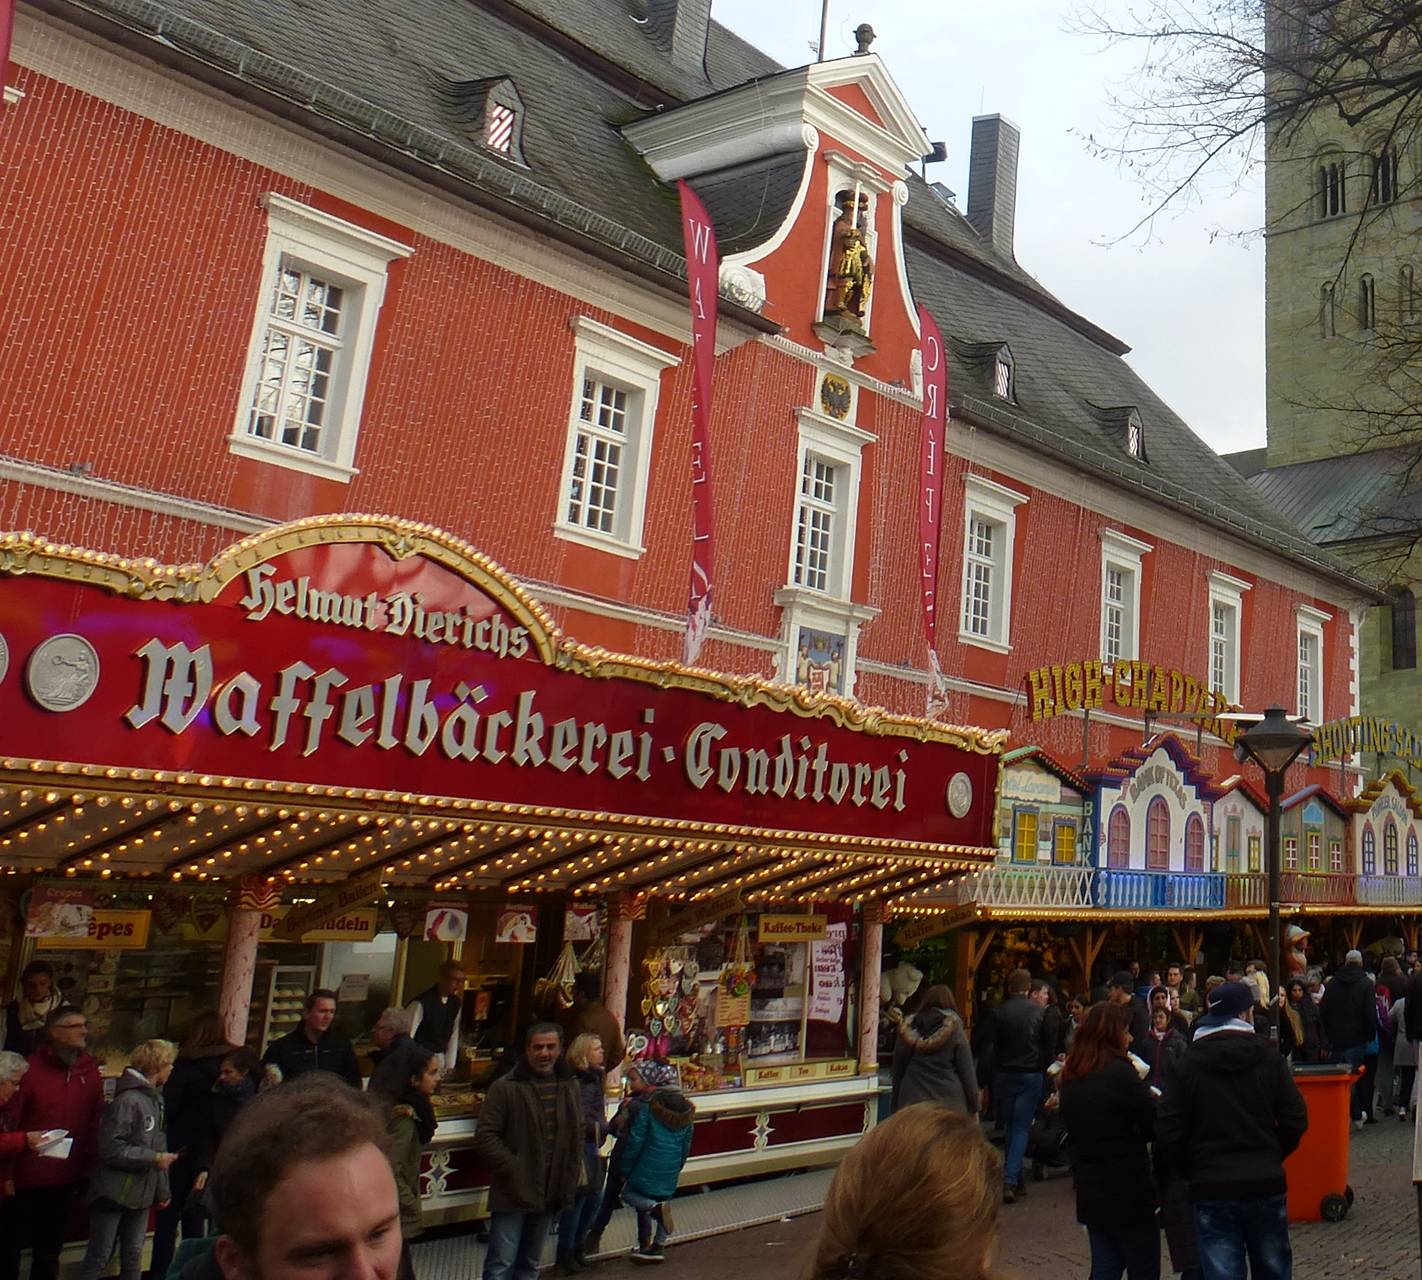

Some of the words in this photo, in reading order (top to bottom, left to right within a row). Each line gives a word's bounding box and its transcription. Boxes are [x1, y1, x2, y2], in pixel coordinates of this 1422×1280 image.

[241, 563, 378, 632] Helmut
[384, 592, 529, 660] Dierichs
[125, 638, 655, 783] Waffelbäckerei
[685, 722, 908, 812] Conditorei
[1154, 765, 1166, 784] OF
[1082, 801, 1093, 868] BANK
[87, 916, 135, 940] êpes
[260, 913, 370, 931] Daudeln
[763, 922, 823, 935] Kaffee-Theke
